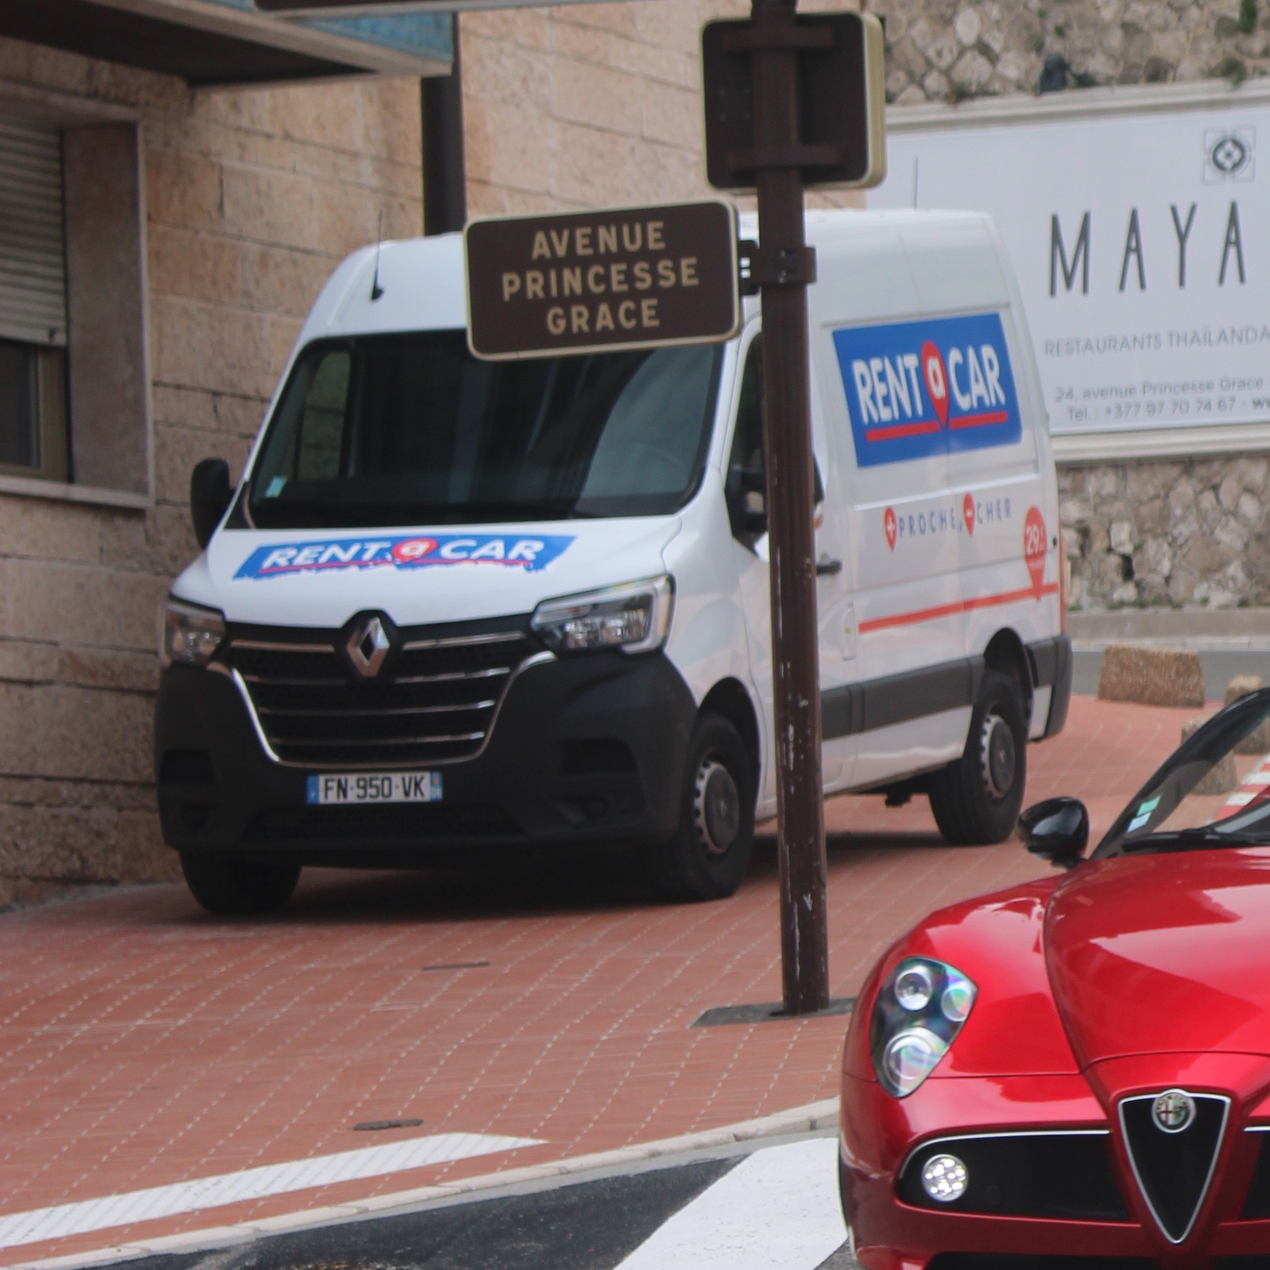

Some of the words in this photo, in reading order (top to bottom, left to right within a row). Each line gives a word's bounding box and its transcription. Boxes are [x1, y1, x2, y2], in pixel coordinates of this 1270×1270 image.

[531, 221, 666, 260] AVENUE
[502, 257, 700, 301] PRINCESSE
[546, 298, 660, 335] GRACE
[1044, 331, 1162, 357] RESTAURANTS
[852, 353, 923, 425] RENT
[926, 356, 946, 400] a
[948, 344, 1006, 412] CAR
[1082, 384, 1137, 400] avenue
[1142, 378, 1215, 396] Princesse
[1219, 374, 1265, 392] Grace
[1104, 401, 1142, 420] +377
[1146, 400, 1166, 418] 97
[1171, 398, 1190, 416] 70
[1196, 397, 1213, 414] 74
[1217, 395, 1236, 413] 67
[976, 497, 1012, 525] CHER
[261, 541, 391, 569] RENT
[440, 538, 545, 561] CAR
